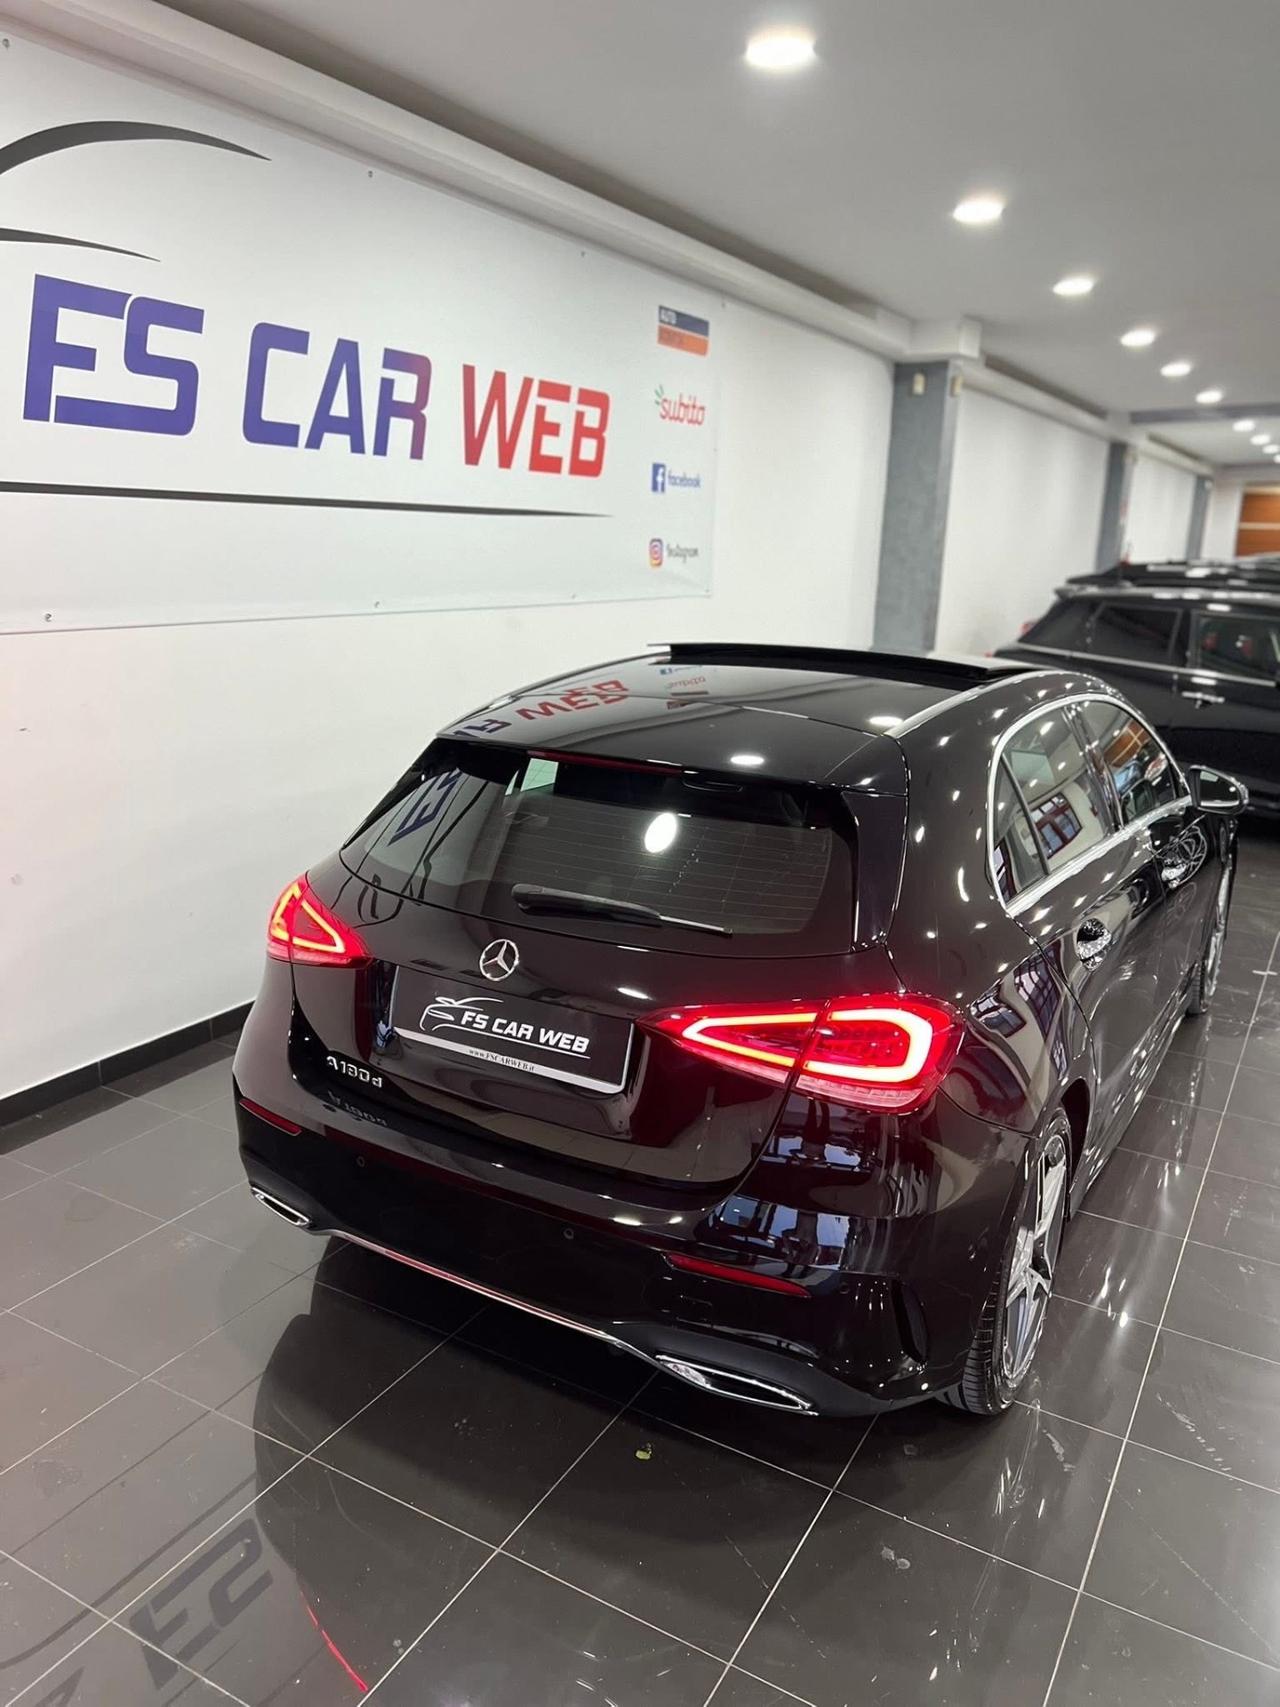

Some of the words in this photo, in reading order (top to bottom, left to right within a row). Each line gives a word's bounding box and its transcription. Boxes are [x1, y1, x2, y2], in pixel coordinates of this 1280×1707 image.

[242, 322, 432, 461] CAR
[461, 364, 611, 478] WEB
[660, 393, 706, 426] subito
[461, 1010, 490, 1030] FS
[492, 1017, 534, 1040] CAR
[539, 1027, 590, 1054] WEB
